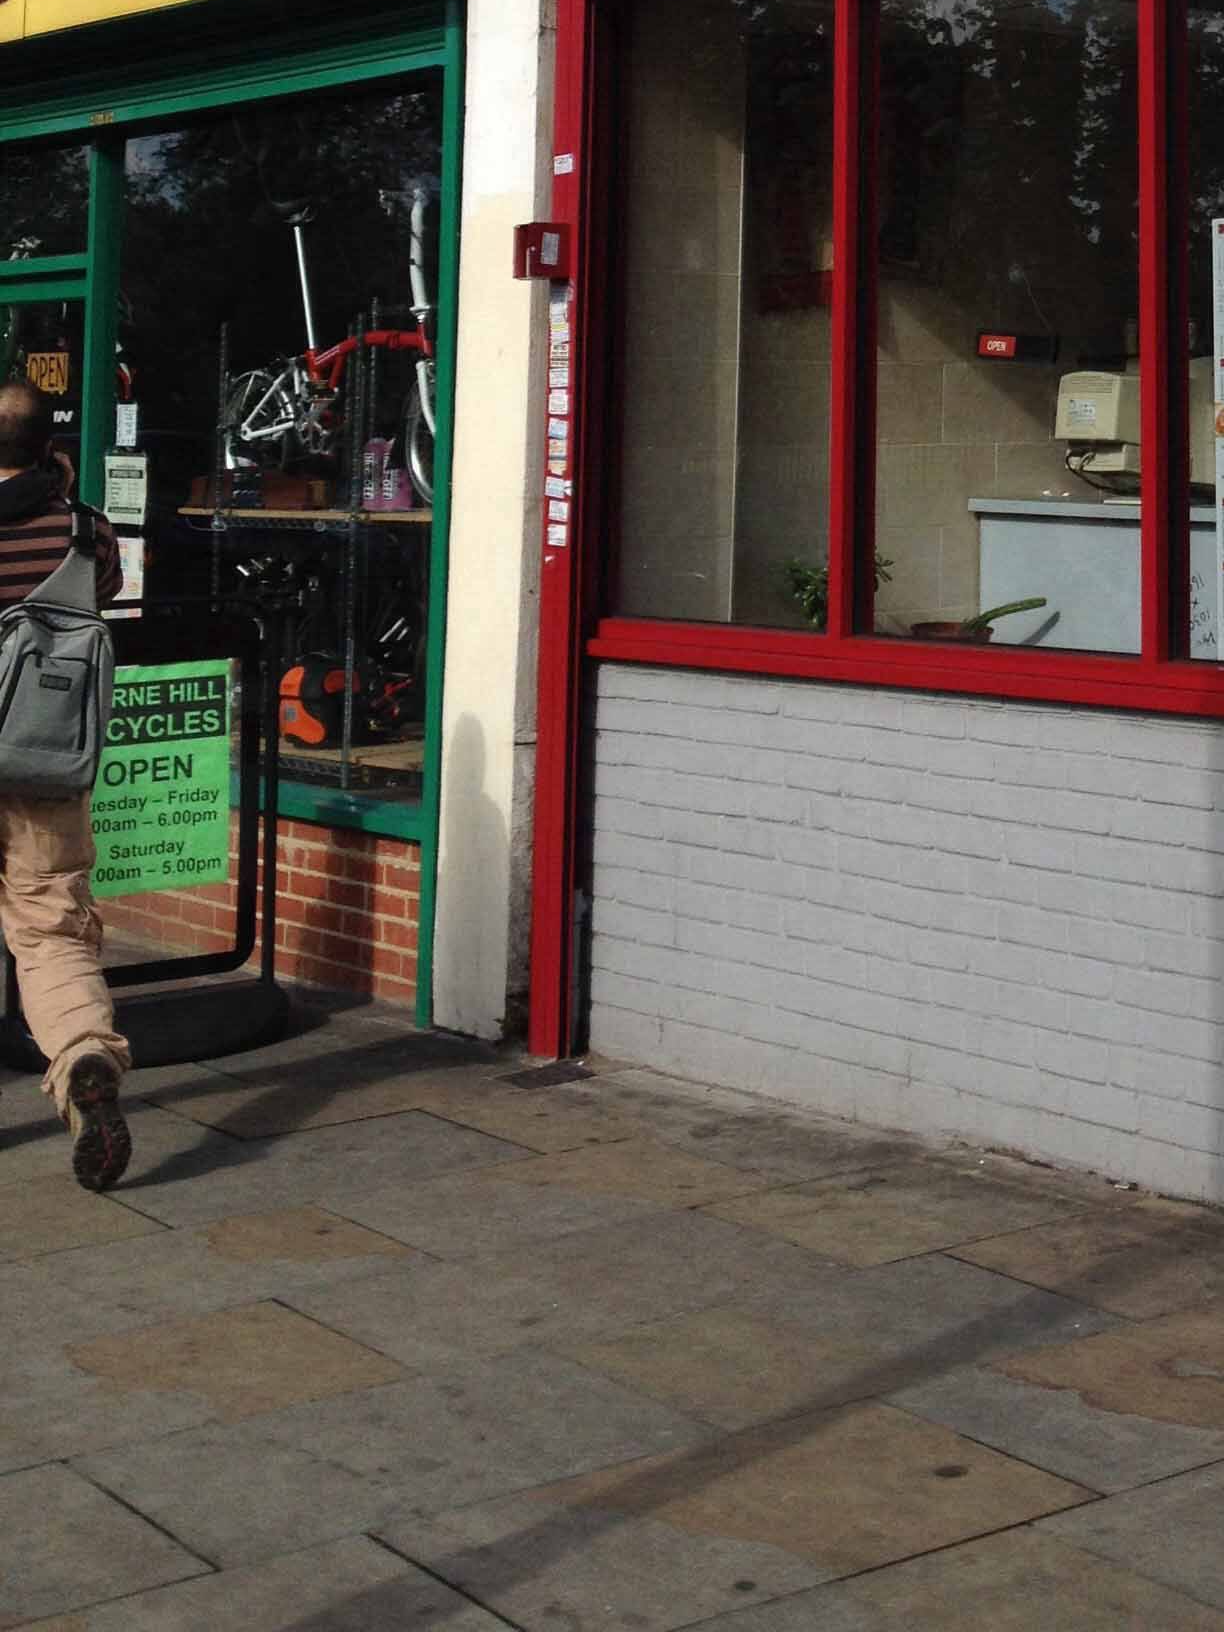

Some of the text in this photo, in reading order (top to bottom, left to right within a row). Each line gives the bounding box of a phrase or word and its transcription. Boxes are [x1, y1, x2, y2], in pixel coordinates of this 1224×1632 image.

[987, 339, 1007, 352] OPEN
[28, 353, 67, 389] OPEN
[111, 680, 222, 709] RNE HILL
[105, 708, 221, 742] CYCLES
[102, 752, 194, 788] OPEN
[91, 794, 149, 814] uesday
[167, 787, 221, 806] Friday
[91, 817, 138, 835] 00am
[158, 809, 218, 828] 6.00pm
[109, 839, 186, 861] Saturday
[91, 865, 142, 884] .00am
[161, 854, 222, 876] 5.00pm
